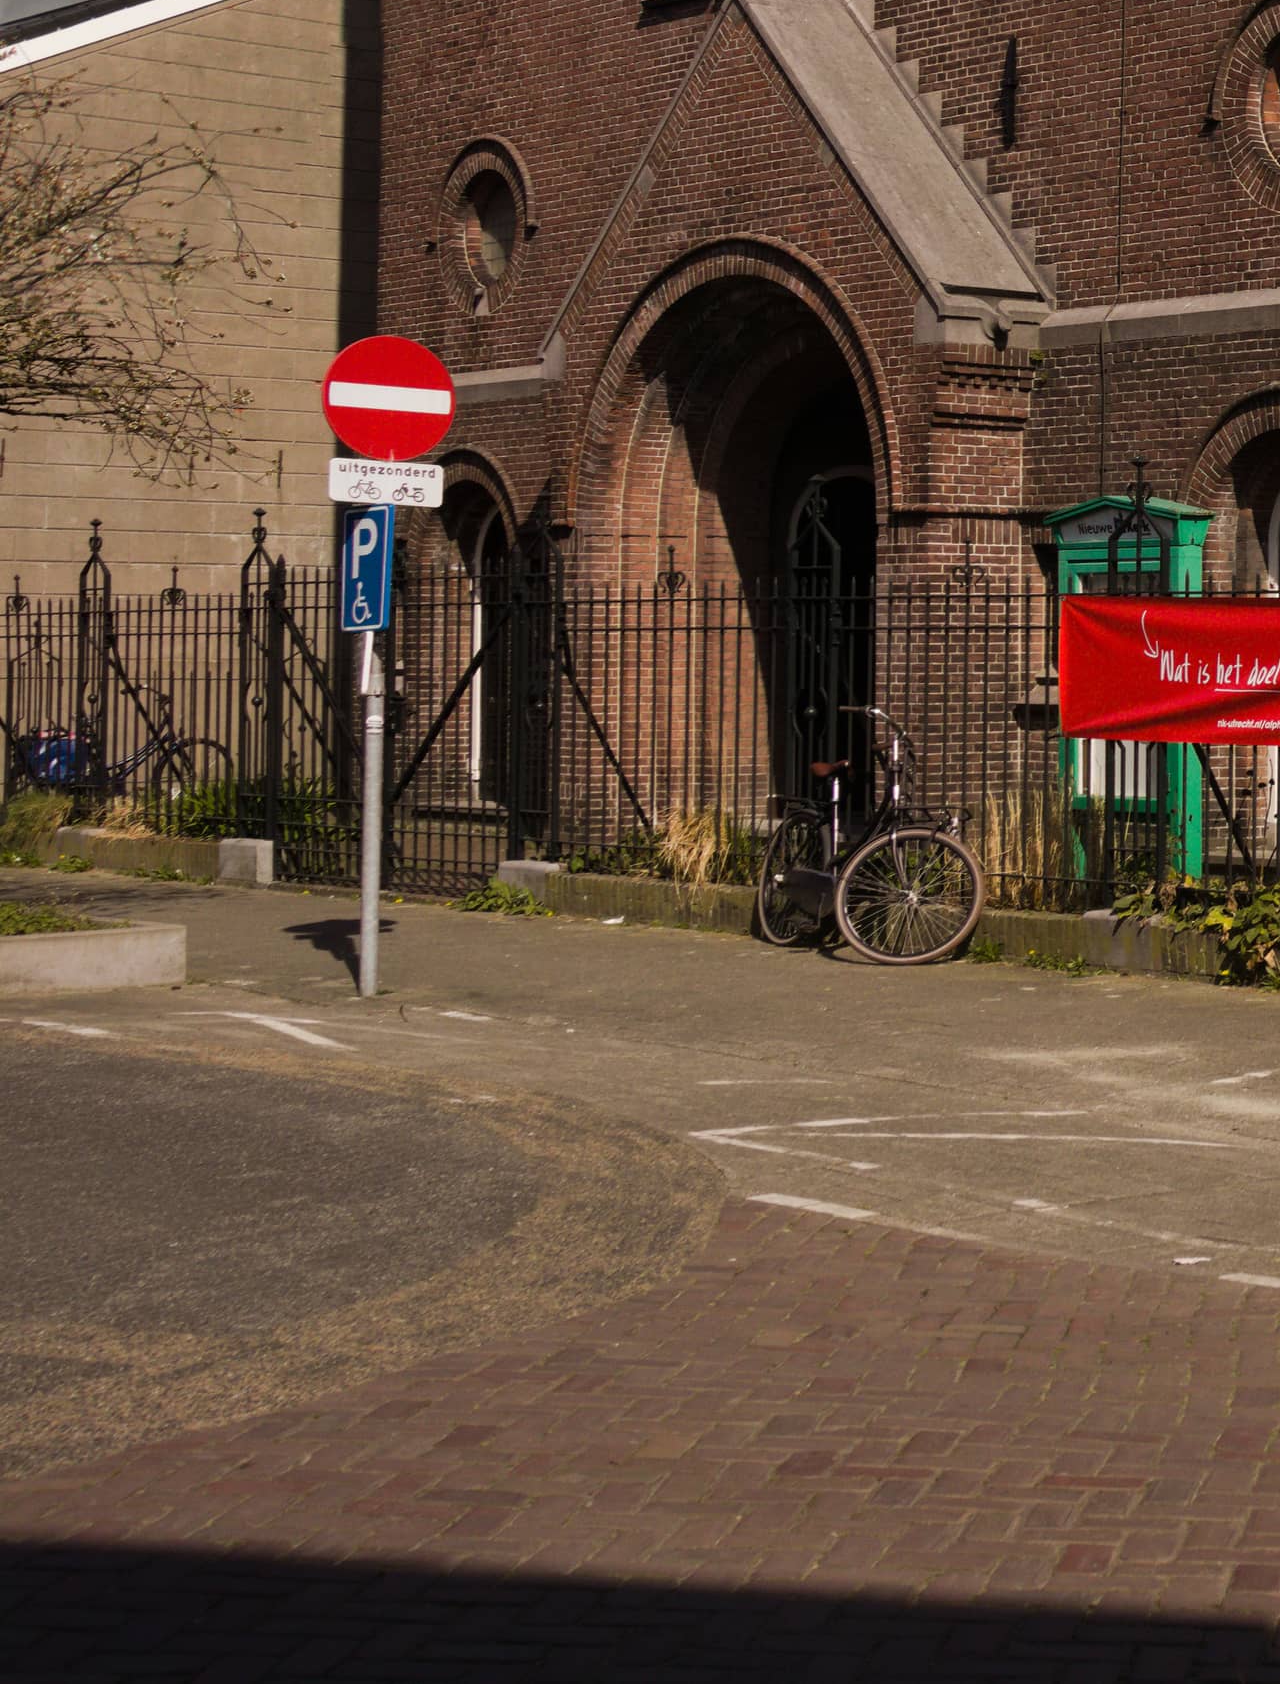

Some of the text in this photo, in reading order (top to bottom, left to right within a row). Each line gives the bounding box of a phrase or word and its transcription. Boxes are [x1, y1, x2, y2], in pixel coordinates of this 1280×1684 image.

[338, 462, 436, 479] uitgezonderd
[1078, 522, 1112, 535] Nieuwe
[351, 517, 378, 579] P
[1160, 649, 1191, 683] Wat
[1197, 660, 1210, 684] is
[1216, 653, 1243, 684] het
